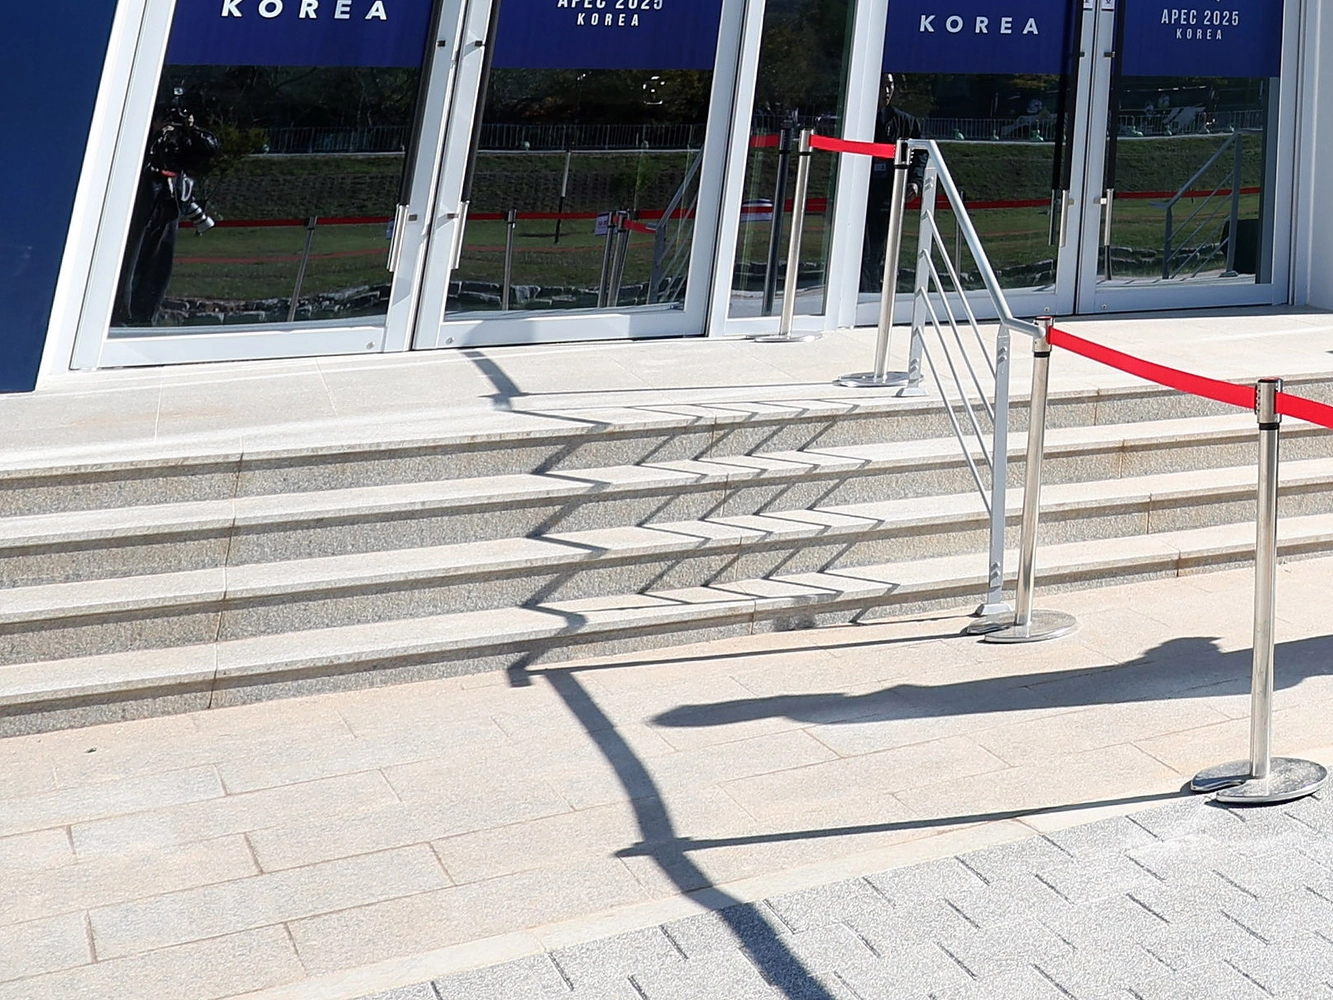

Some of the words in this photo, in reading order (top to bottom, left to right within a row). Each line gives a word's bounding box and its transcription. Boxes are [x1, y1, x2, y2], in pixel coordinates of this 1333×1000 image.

[576, 12, 639, 27] KOREA
[919, 14, 1039, 35] KOREA
[1161, 8, 1197, 25] APEC
[1203, 9, 1239, 26] 2025
[1176, 27, 1222, 41] KOREA
